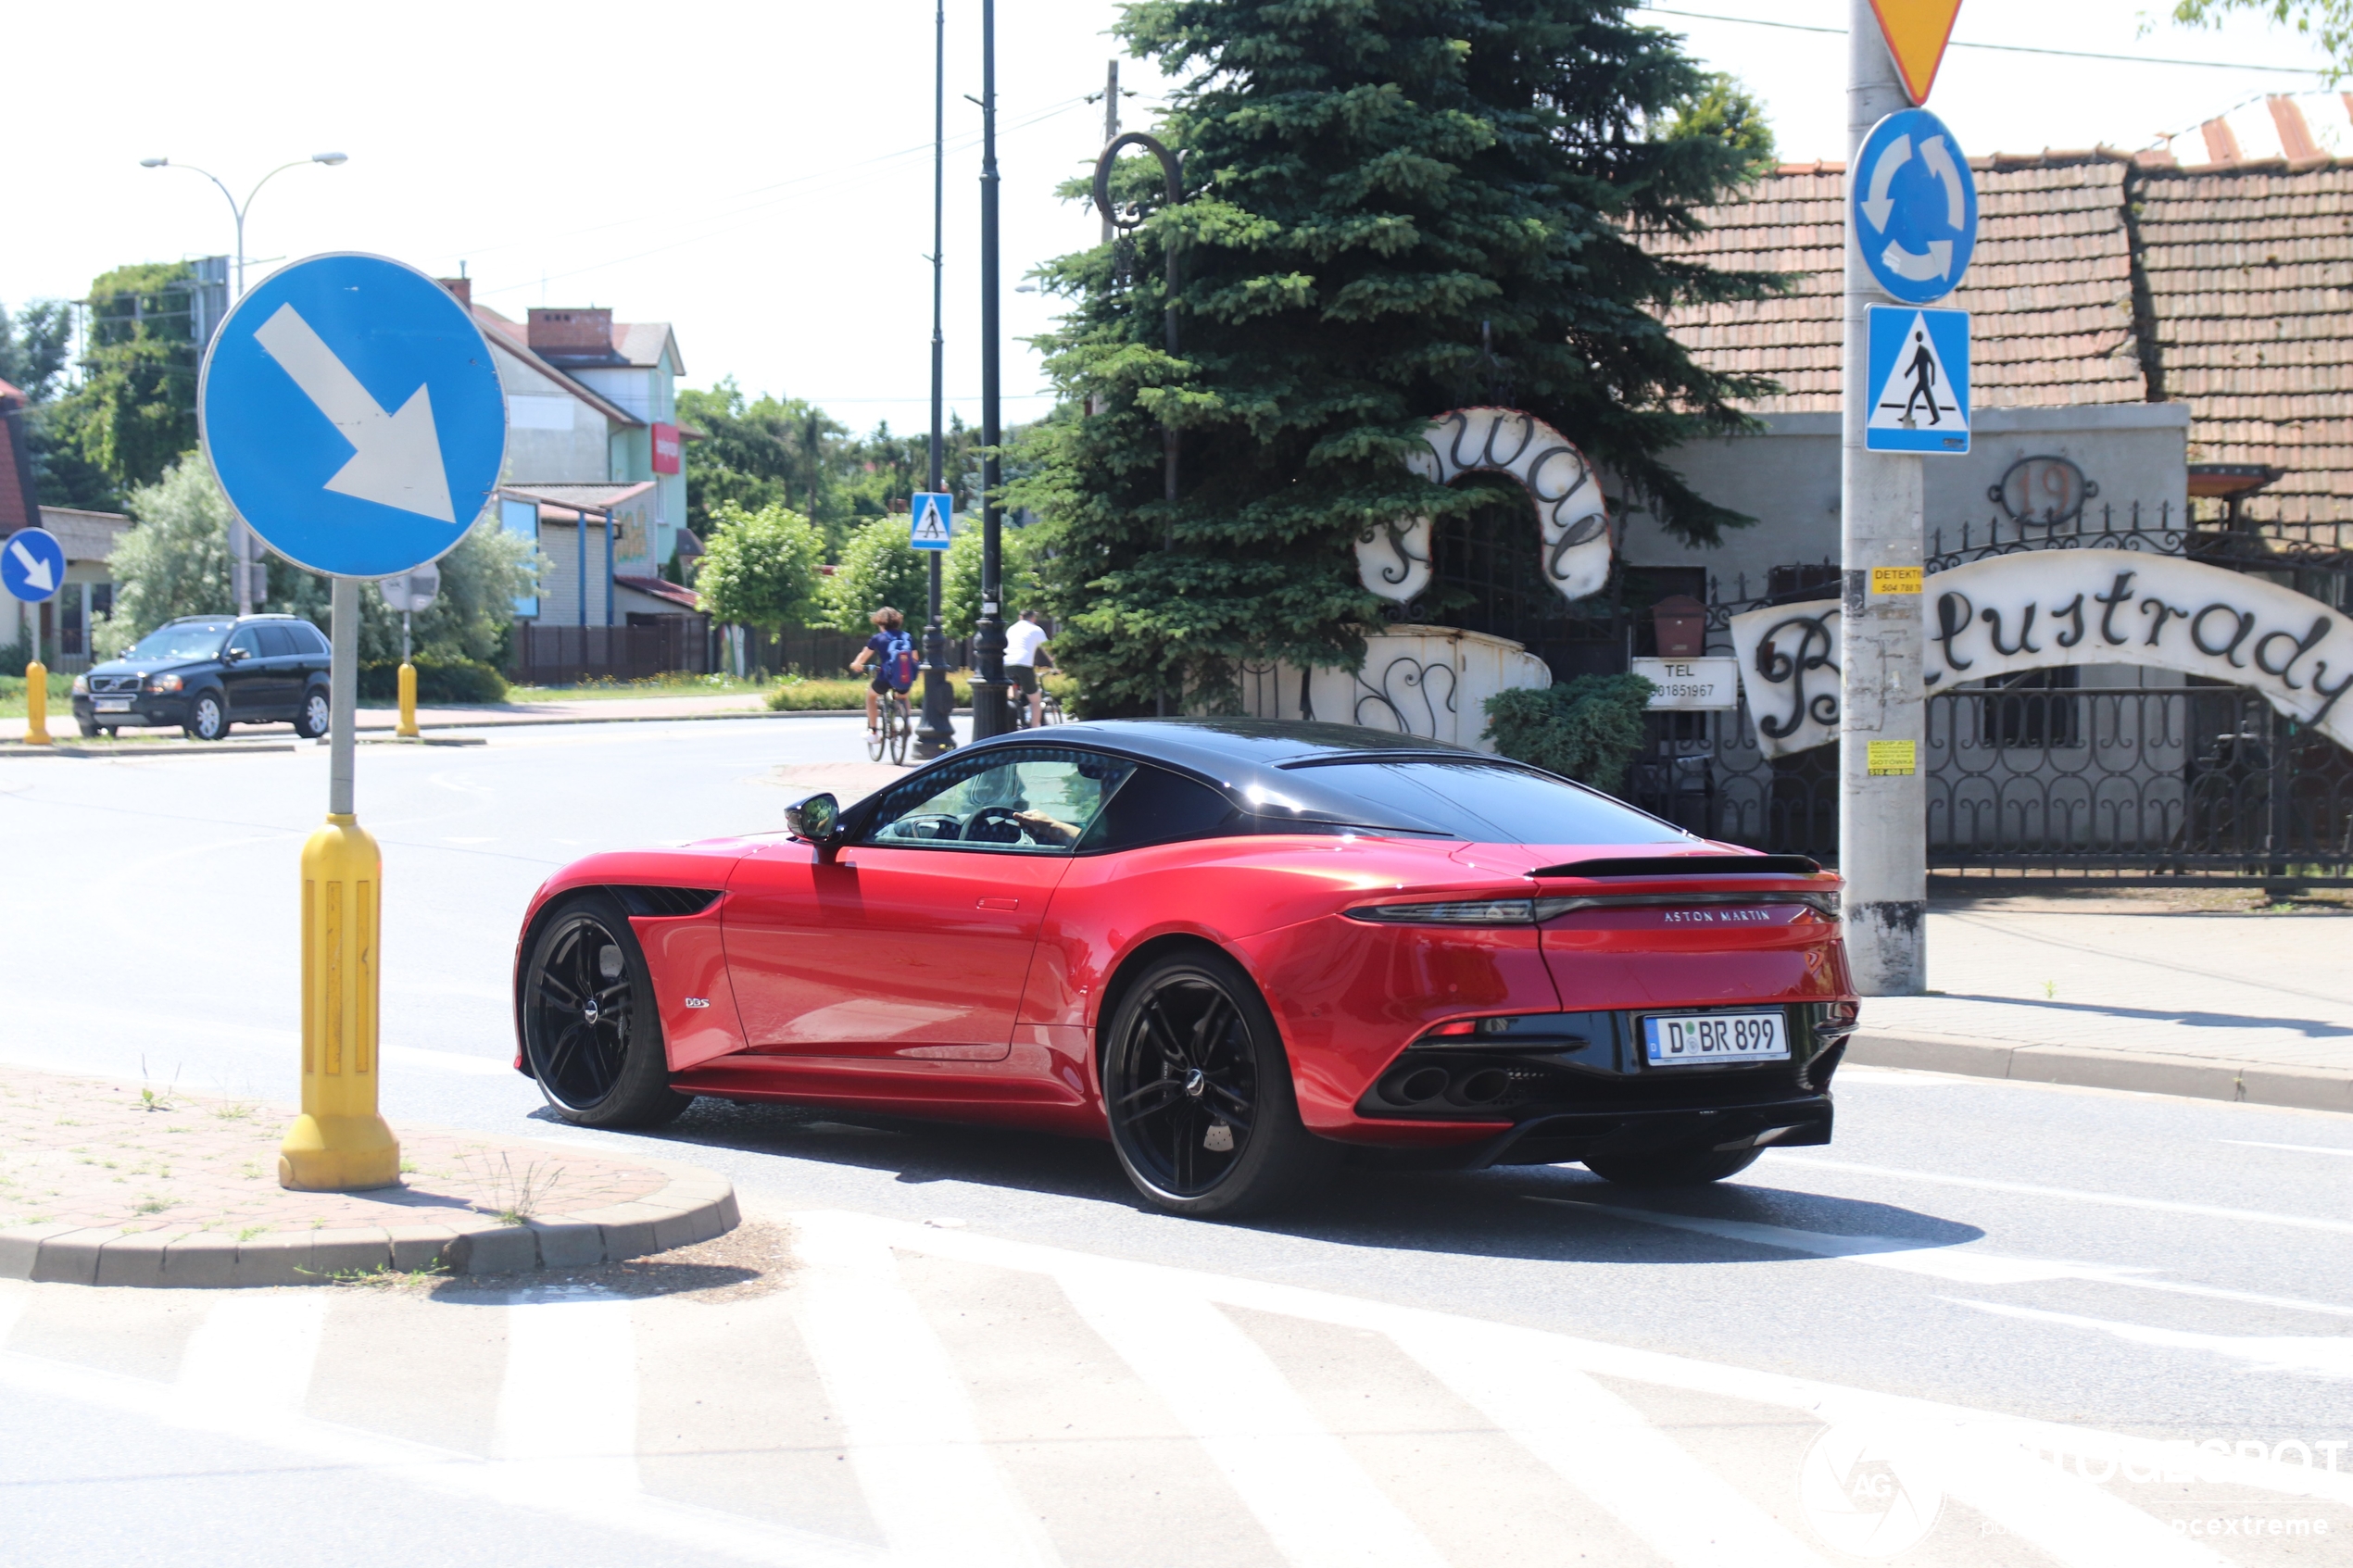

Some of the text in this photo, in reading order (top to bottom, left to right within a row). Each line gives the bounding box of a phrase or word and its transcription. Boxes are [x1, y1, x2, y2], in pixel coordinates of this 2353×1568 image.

[2017, 465, 2070, 517] 19
[1755, 571, 2353, 739] Blustrady
[1665, 664, 1694, 677] TEL
[1665, 909, 1770, 922] ASTON MARTIN
[686, 997, 711, 1009] DBS
[1668, 1019, 1774, 1053] D BR 899
